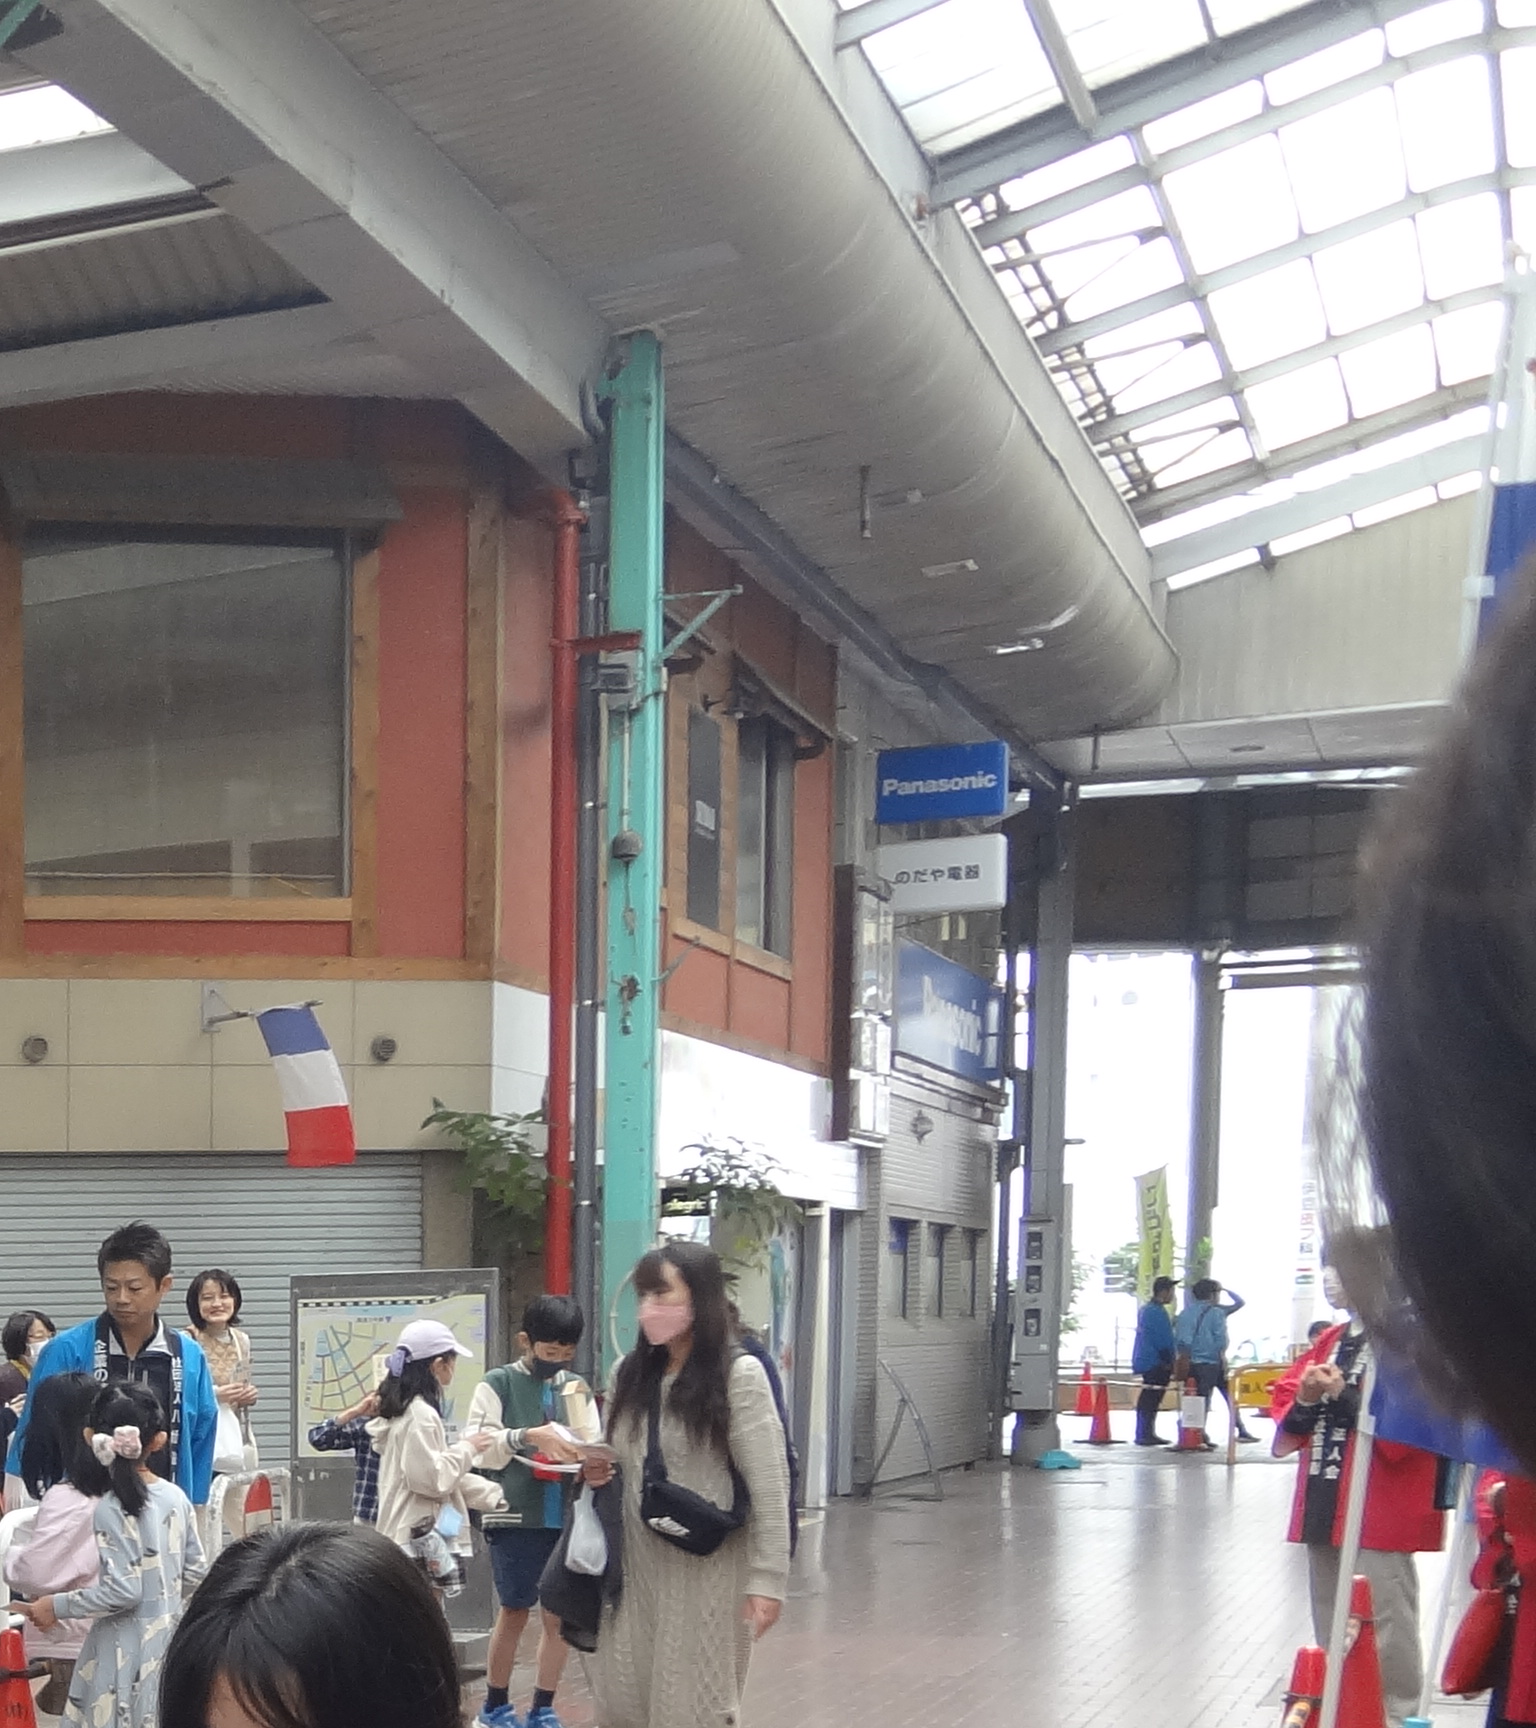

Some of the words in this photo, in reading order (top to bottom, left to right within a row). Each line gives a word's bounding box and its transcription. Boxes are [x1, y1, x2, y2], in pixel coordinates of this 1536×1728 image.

[881, 770, 998, 797] Panasonic
[894, 863, 981, 885] のだや電器
